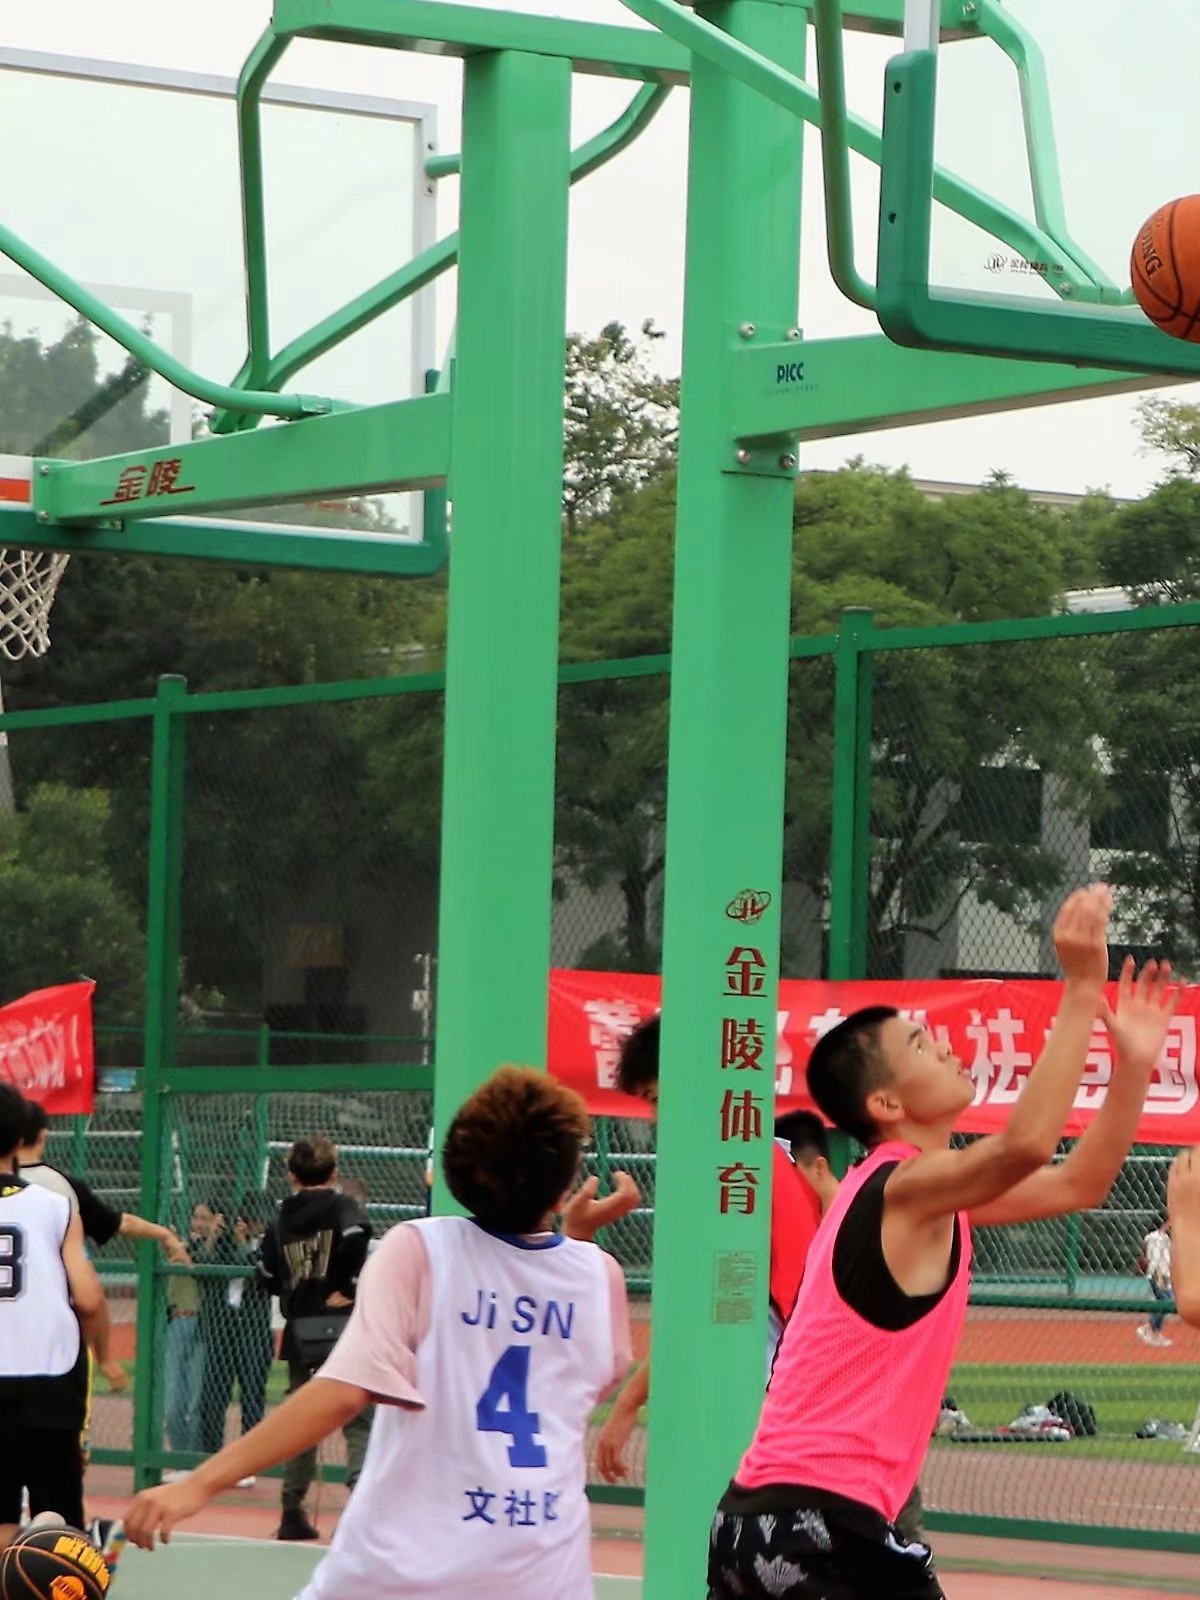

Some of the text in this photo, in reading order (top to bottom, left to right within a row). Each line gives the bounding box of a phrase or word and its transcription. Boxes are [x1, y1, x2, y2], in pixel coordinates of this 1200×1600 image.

[777, 361, 804, 384] PICC
[100, 459, 195, 506] 金陵
[717, 946, 769, 1215] 金陵体育
[461, 1289, 575, 1340] Ji SN
[476, 1344, 542, 1468] 4
